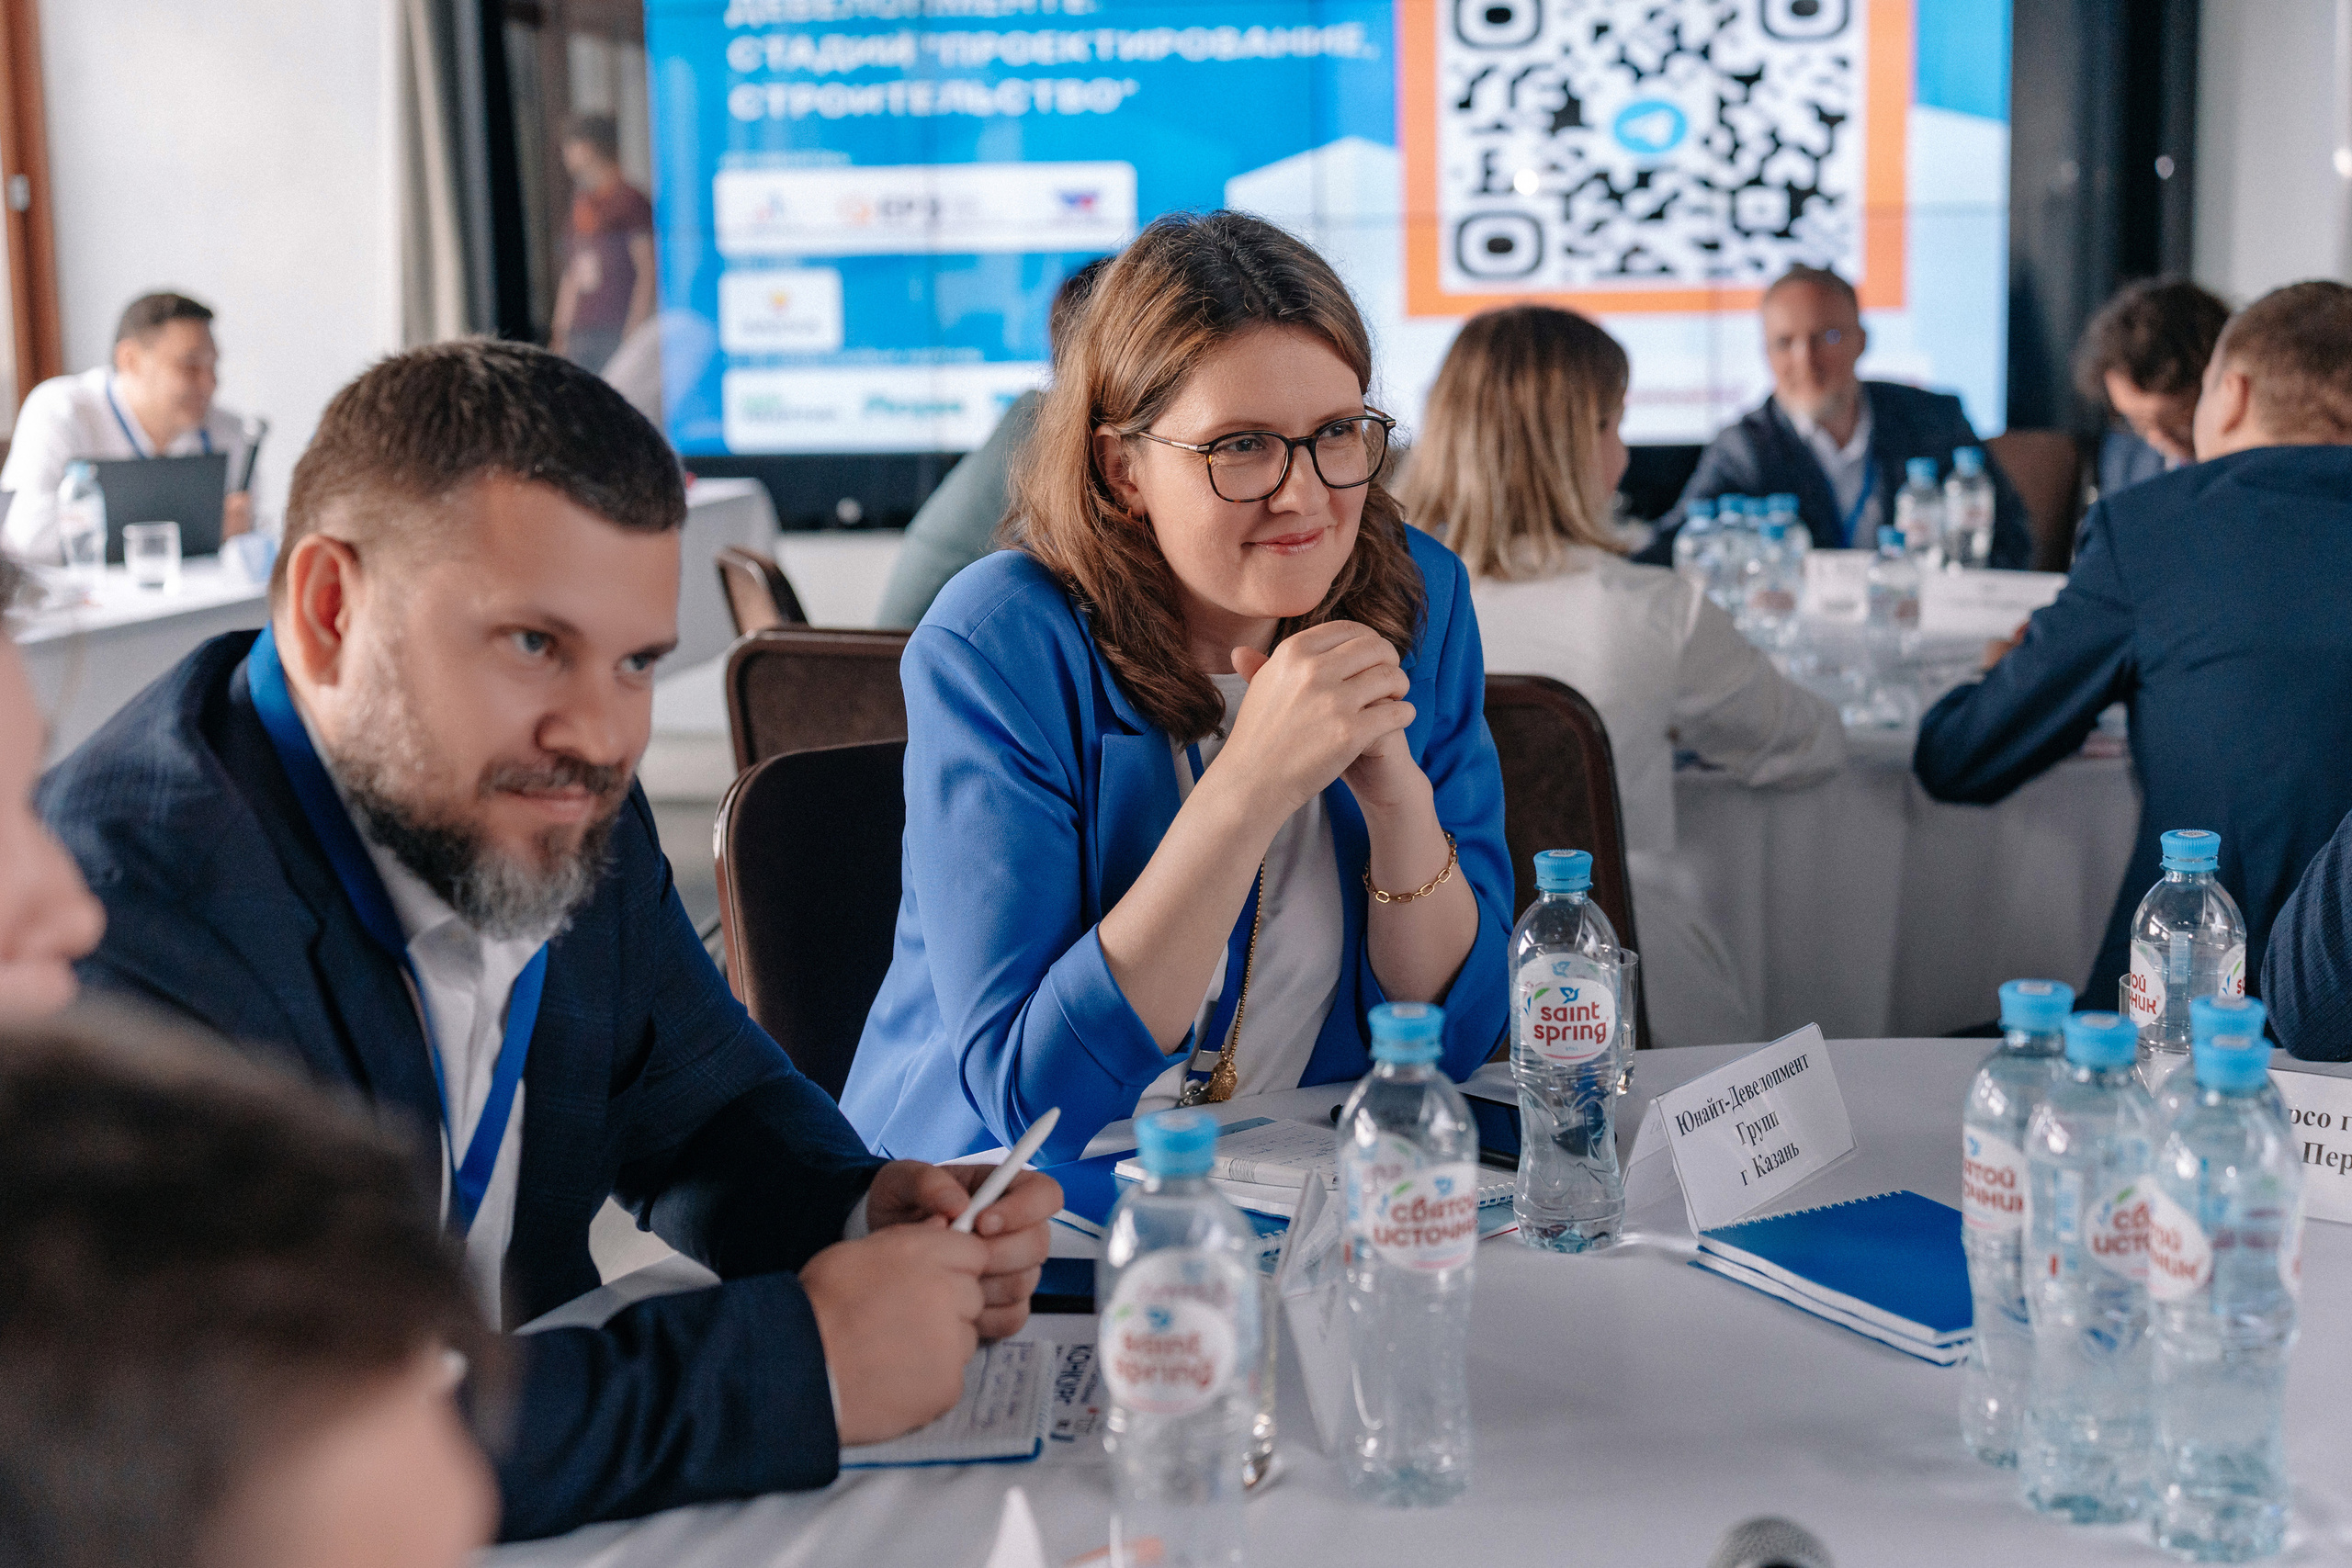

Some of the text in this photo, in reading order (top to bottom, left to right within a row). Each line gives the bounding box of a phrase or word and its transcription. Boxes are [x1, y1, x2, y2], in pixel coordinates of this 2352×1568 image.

[1541, 1001, 1600, 1021] saint
[1533, 1022, 1606, 1046] spring
[1675, 1054, 1810, 1136] Юнайт-Девелопмент
[1736, 1111, 1780, 1146] Групп
[1751, 1142, 1800, 1179] Казань
